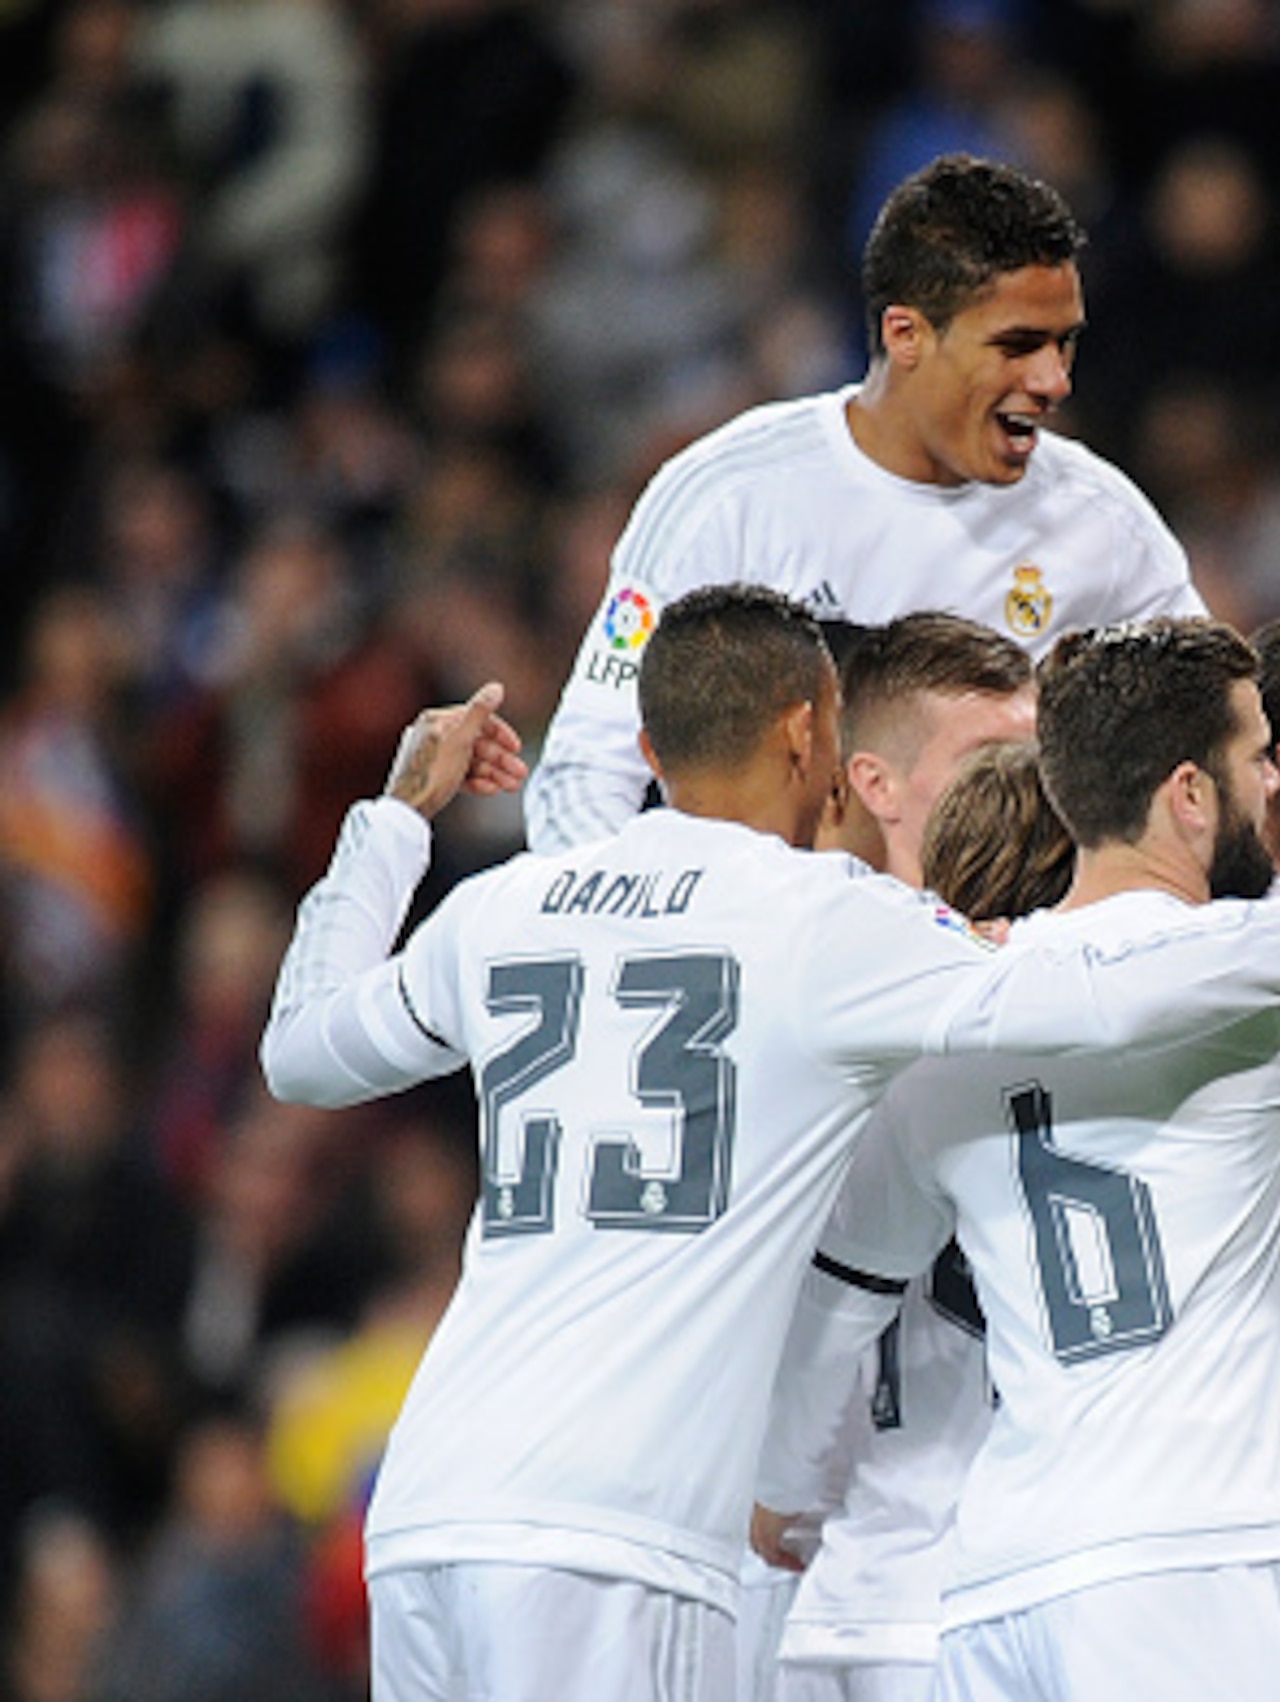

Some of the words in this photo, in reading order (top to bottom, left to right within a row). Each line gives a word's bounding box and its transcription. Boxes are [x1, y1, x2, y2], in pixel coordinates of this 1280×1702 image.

[586, 651, 639, 689] LFP
[540, 869, 704, 918] DANILO
[479, 943, 742, 1241] 23
[1002, 1078, 1176, 1368] 6
